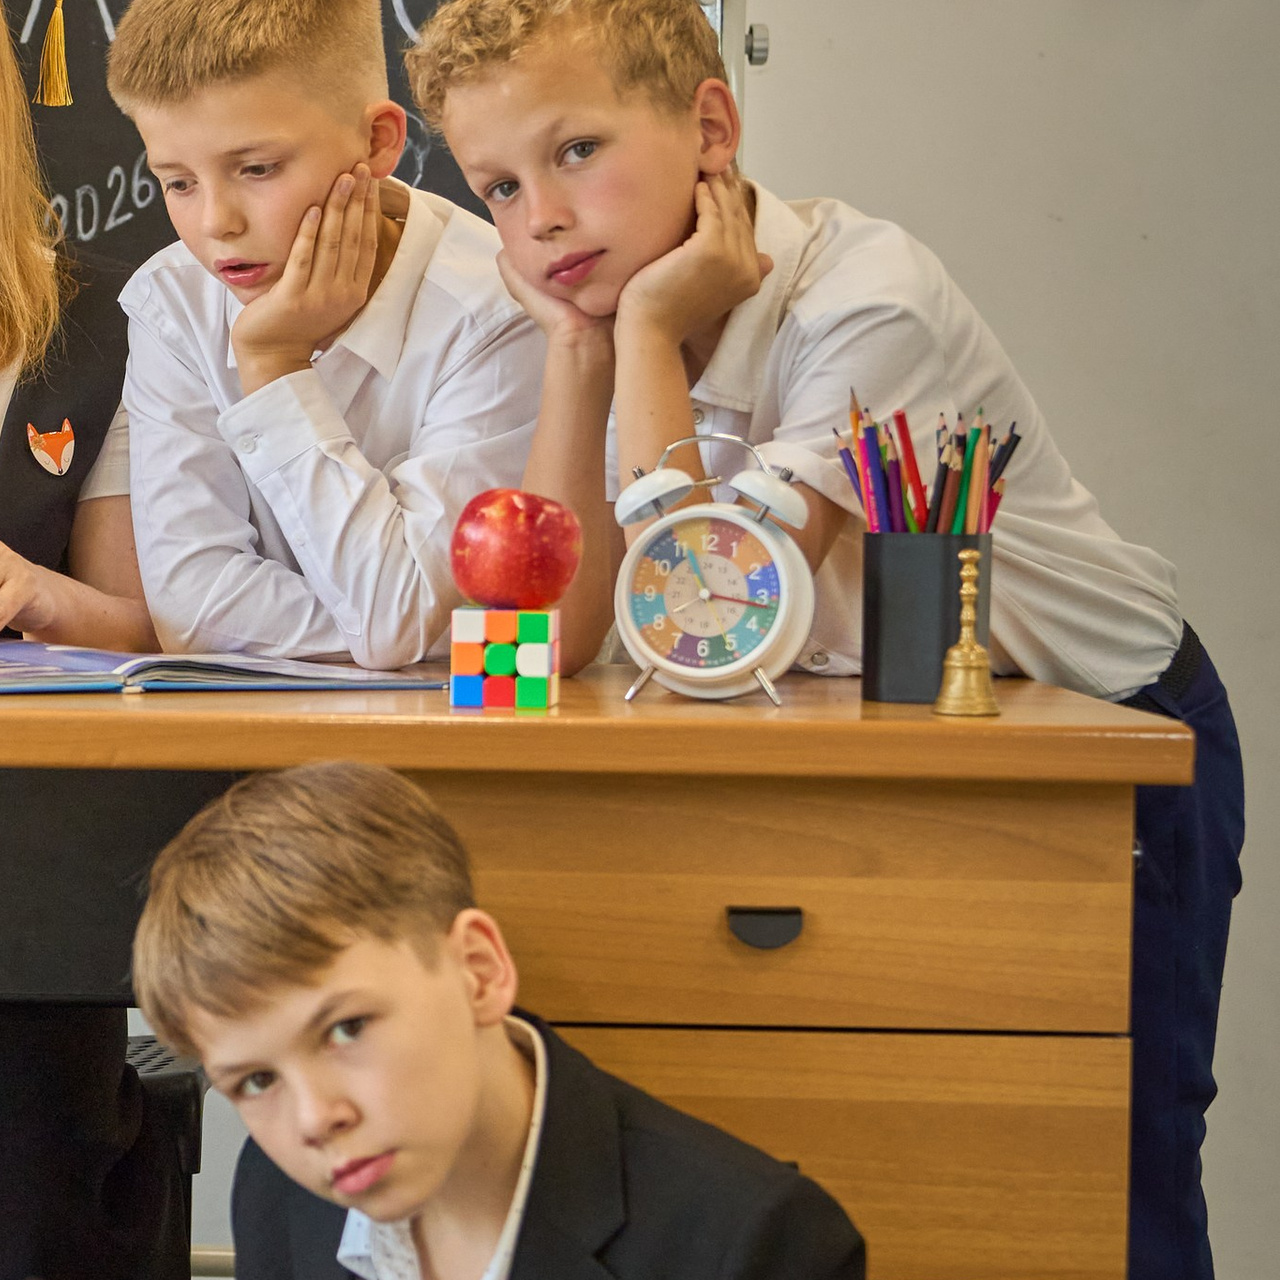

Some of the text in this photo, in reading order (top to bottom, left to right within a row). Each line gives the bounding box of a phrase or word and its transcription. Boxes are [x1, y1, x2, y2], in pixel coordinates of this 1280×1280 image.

[674, 541, 688, 558] 11
[701, 534, 719, 552] 12
[730, 541, 738, 558] 1
[654, 559, 671, 577] 10
[749, 563, 761, 580] 2
[644, 585, 656, 602] 9
[756, 589, 769, 606] 3
[653, 613, 665, 631] 8
[745, 615, 758, 632] 4
[671, 632, 684, 649] 7
[696, 639, 709, 657] 6
[725, 633, 737, 651] 5
